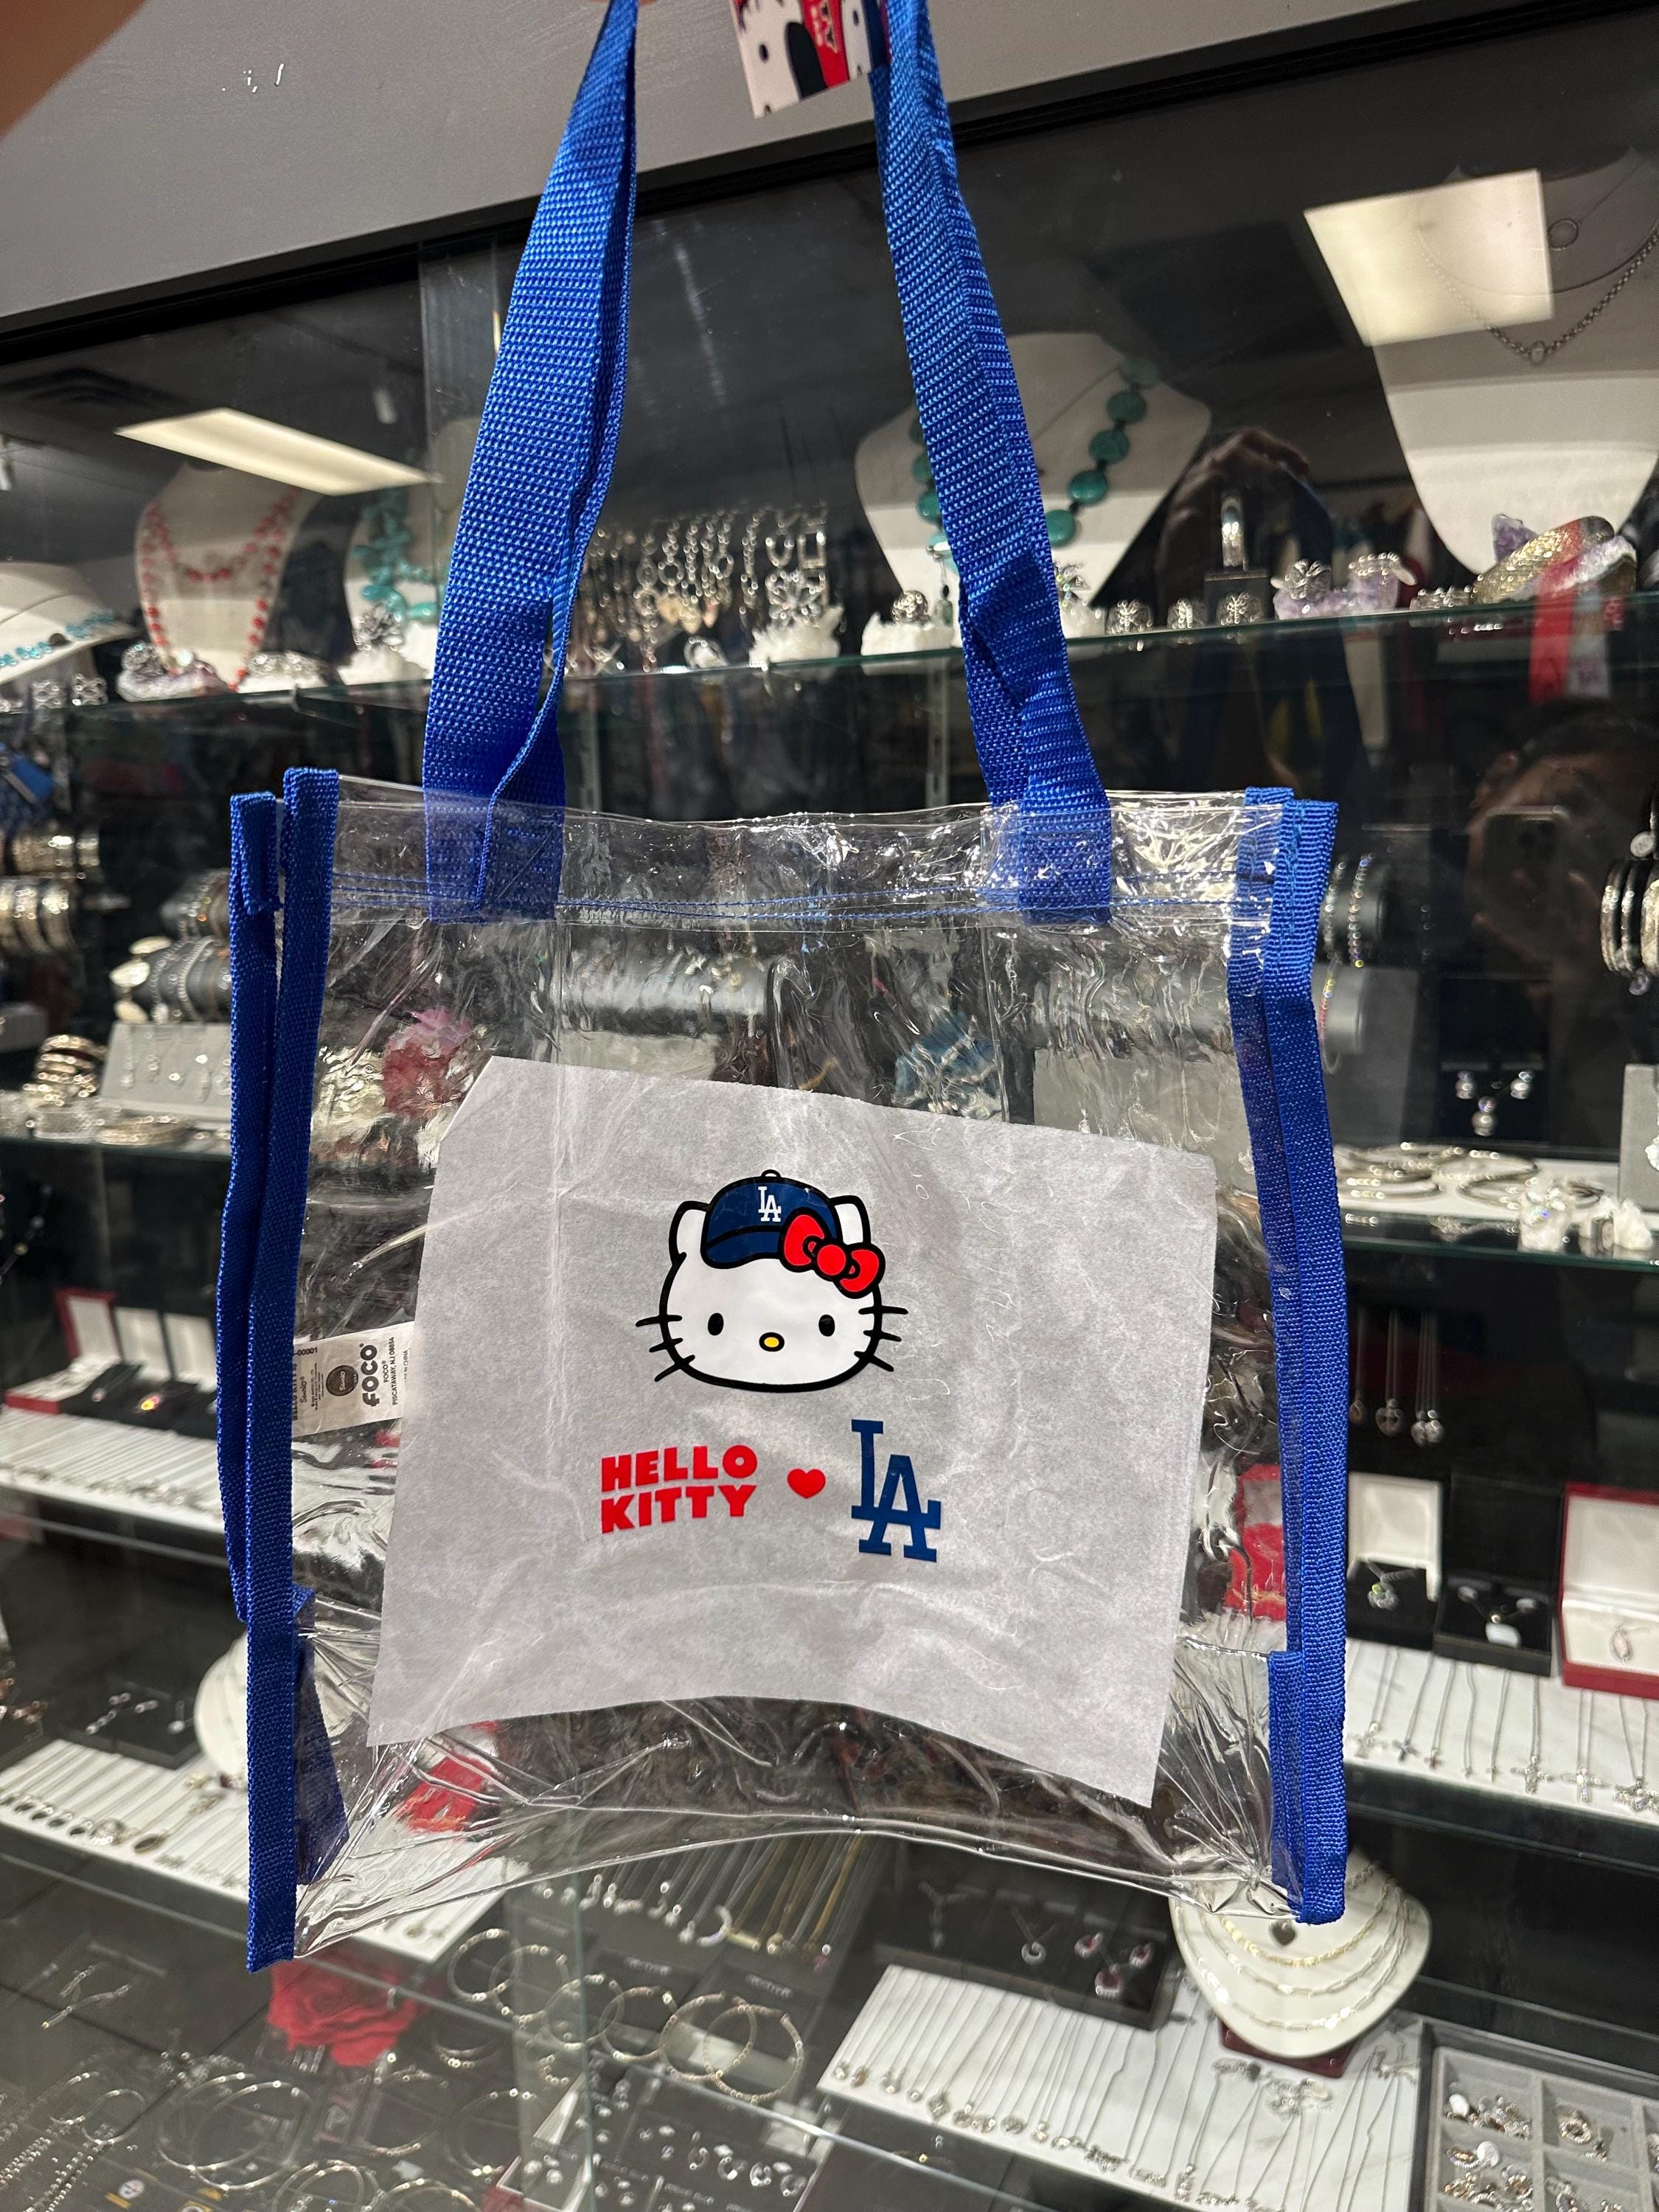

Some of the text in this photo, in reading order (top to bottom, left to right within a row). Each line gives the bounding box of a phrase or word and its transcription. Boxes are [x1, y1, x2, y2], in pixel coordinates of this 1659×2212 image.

[758, 1186, 782, 1222] LA
[389, 1356, 396, 1365] NJ
[601, 1444, 758, 1492] HELLO
[851, 1419, 942, 1562] LA
[601, 1484, 757, 1534] KITTY
